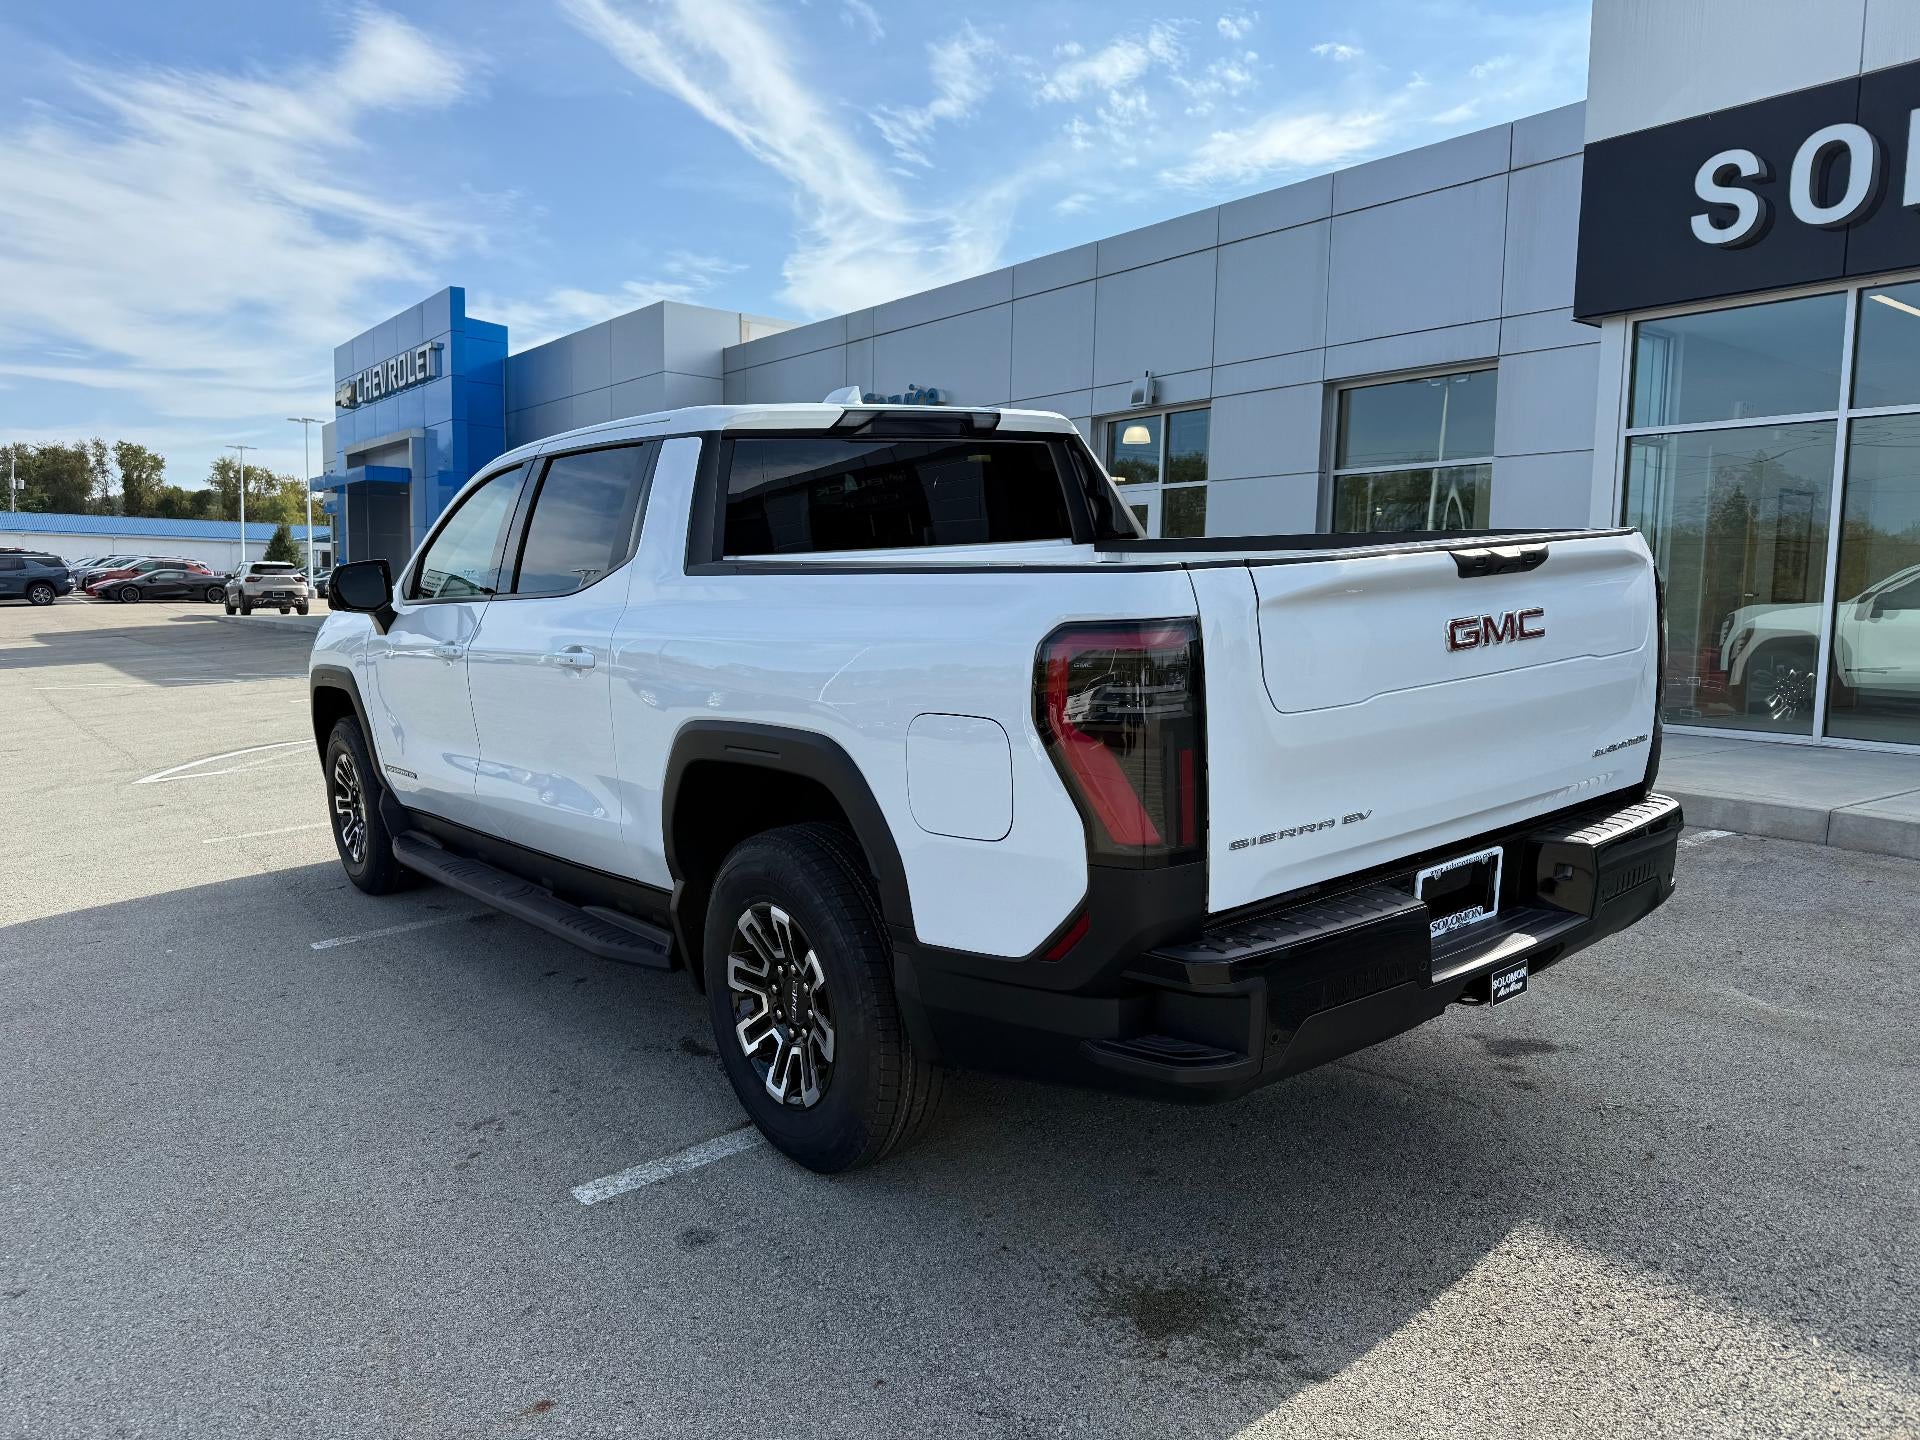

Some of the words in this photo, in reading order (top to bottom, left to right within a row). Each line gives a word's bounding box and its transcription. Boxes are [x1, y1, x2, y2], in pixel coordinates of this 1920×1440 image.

[1691, 108, 1920, 243] SO
[356, 342, 435, 403] CHEVROLET
[1445, 606, 1546, 653] GMC
[1229, 818, 1335, 850] SIERRA
[1342, 809, 1372, 825] EV
[1431, 906, 1483, 933] SOLOMON
[1493, 967, 1527, 990] SOLOMON
